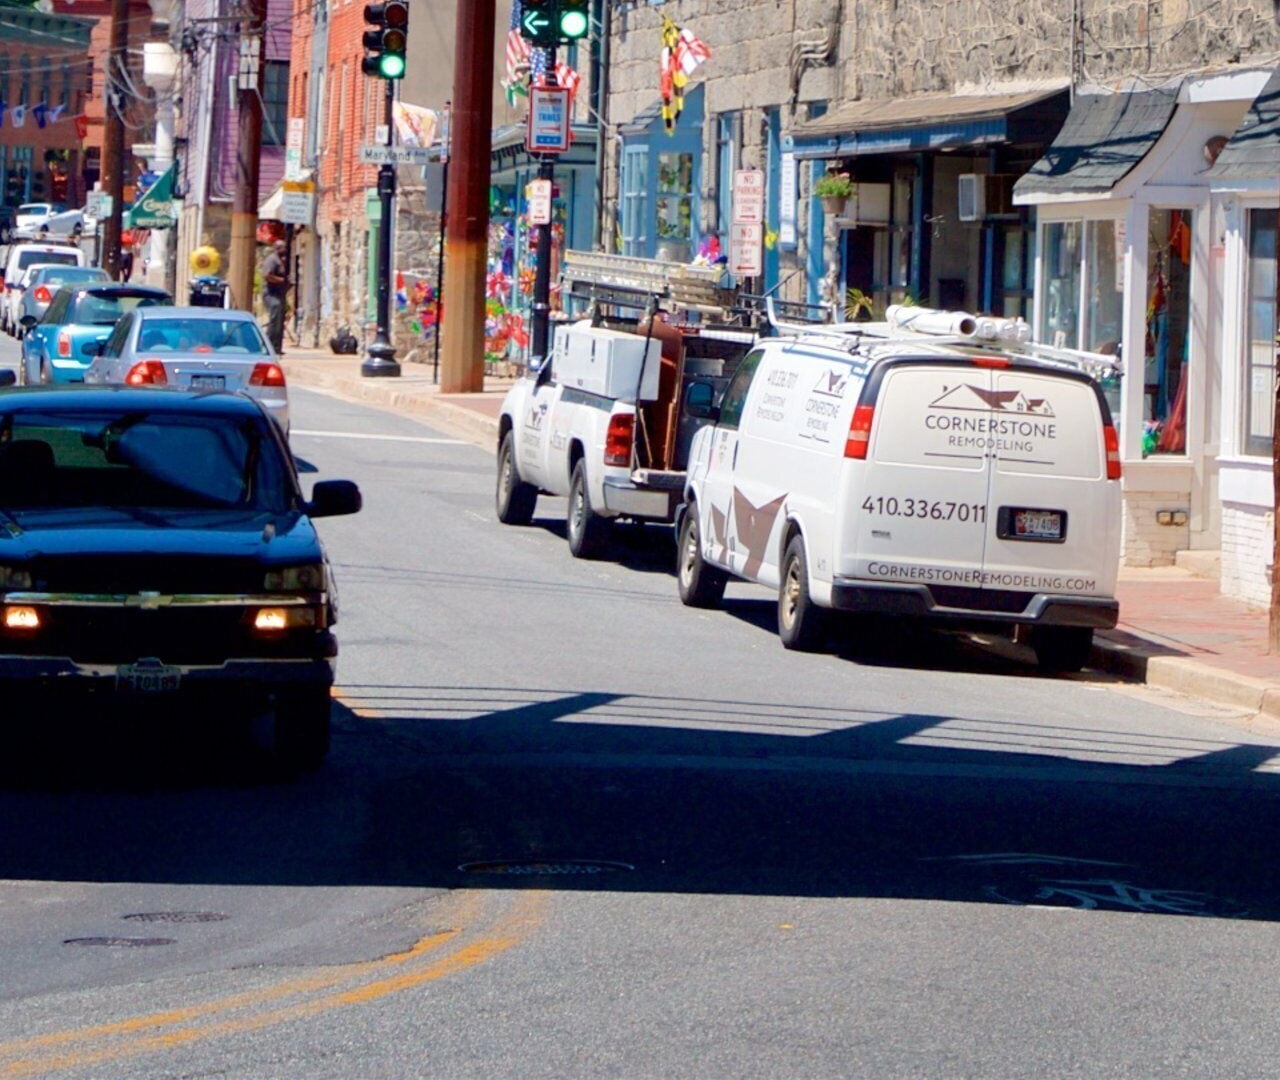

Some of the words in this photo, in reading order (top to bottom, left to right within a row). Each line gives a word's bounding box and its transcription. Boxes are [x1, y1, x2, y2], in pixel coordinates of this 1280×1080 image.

[364, 148, 412, 162] Maryland
[743, 175, 754, 184] NO
[740, 228, 753, 237] NO
[925, 415, 1057, 439] CORNERSTONE
[948, 435, 1034, 452] REMODELING
[862, 496, 986, 523] 410.336.7011
